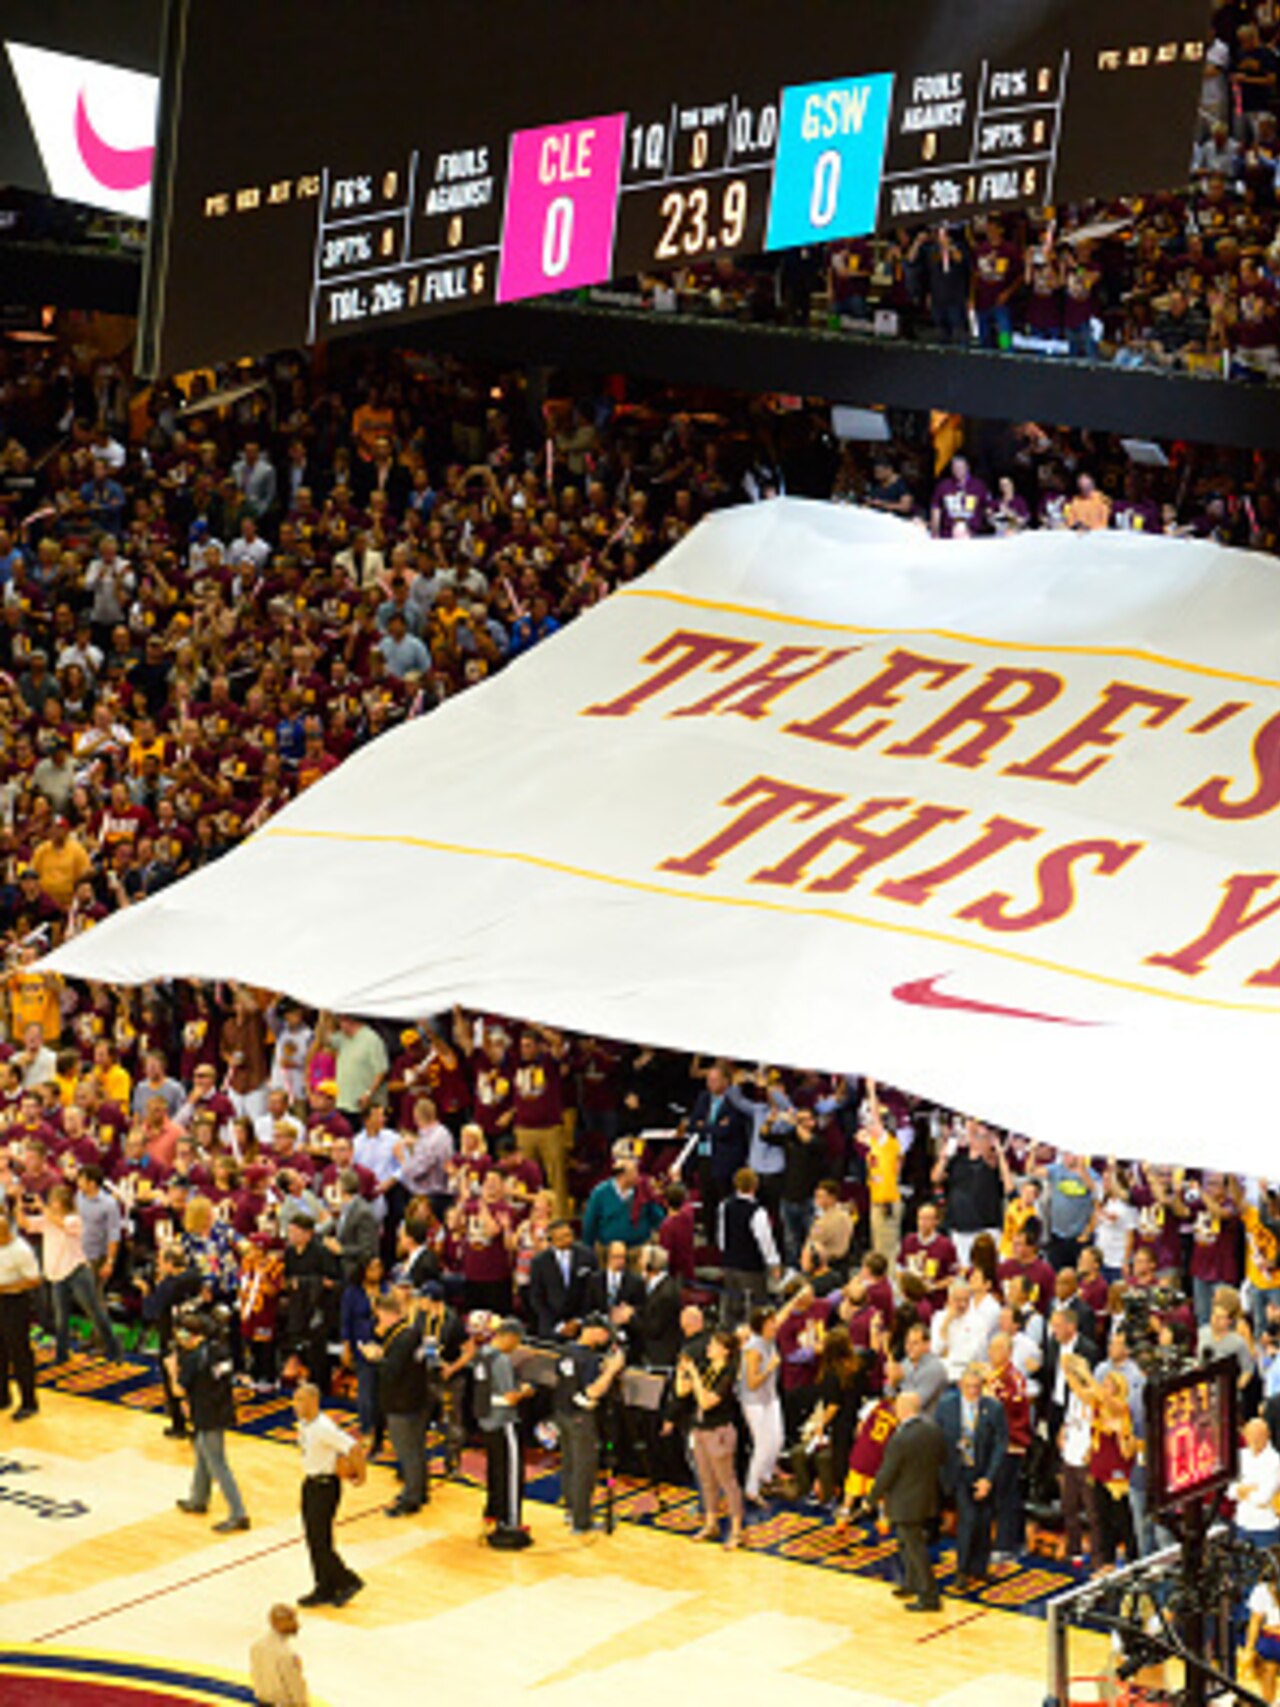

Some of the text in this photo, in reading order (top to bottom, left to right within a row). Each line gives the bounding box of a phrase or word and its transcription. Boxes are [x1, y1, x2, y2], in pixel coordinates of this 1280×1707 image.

[801, 86, 871, 140] GSW
[913, 72, 962, 103] FOULS
[631, 123, 664, 170] 1Q
[692, 130, 708, 168] 0
[736, 105, 776, 152] 0.0
[434, 147, 489, 182] FOULS
[538, 129, 596, 185] CLE
[810, 150, 841, 228] 0
[542, 196, 574, 277] 0
[655, 181, 748, 260] 23.9
[655, 773, 1146, 934] THIS
